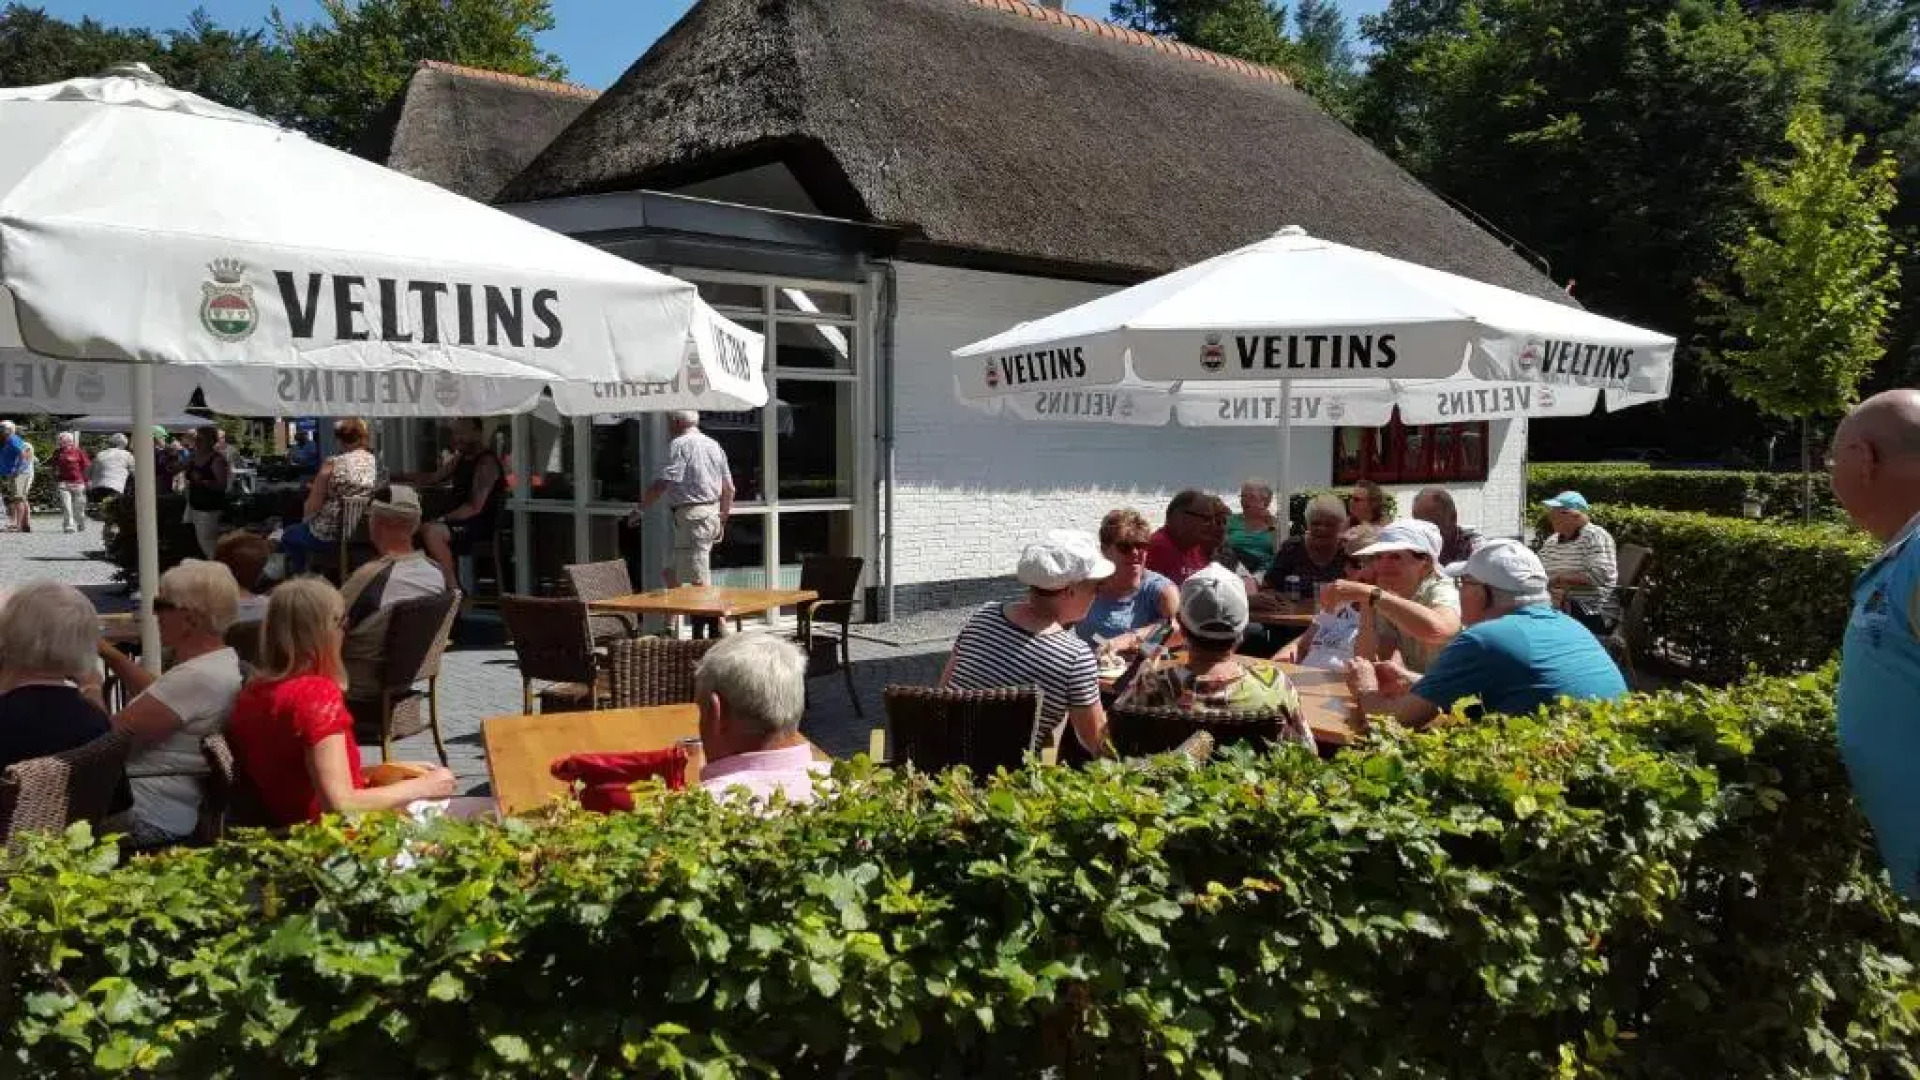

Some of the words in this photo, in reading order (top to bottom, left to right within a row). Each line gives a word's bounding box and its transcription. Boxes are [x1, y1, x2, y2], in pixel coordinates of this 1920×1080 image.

[272, 269, 563, 349] VELTINS
[1000, 346, 1087, 385] VELTINS
[1236, 333, 1397, 369] VELTINS
[1541, 339, 1635, 380] VELTINS
